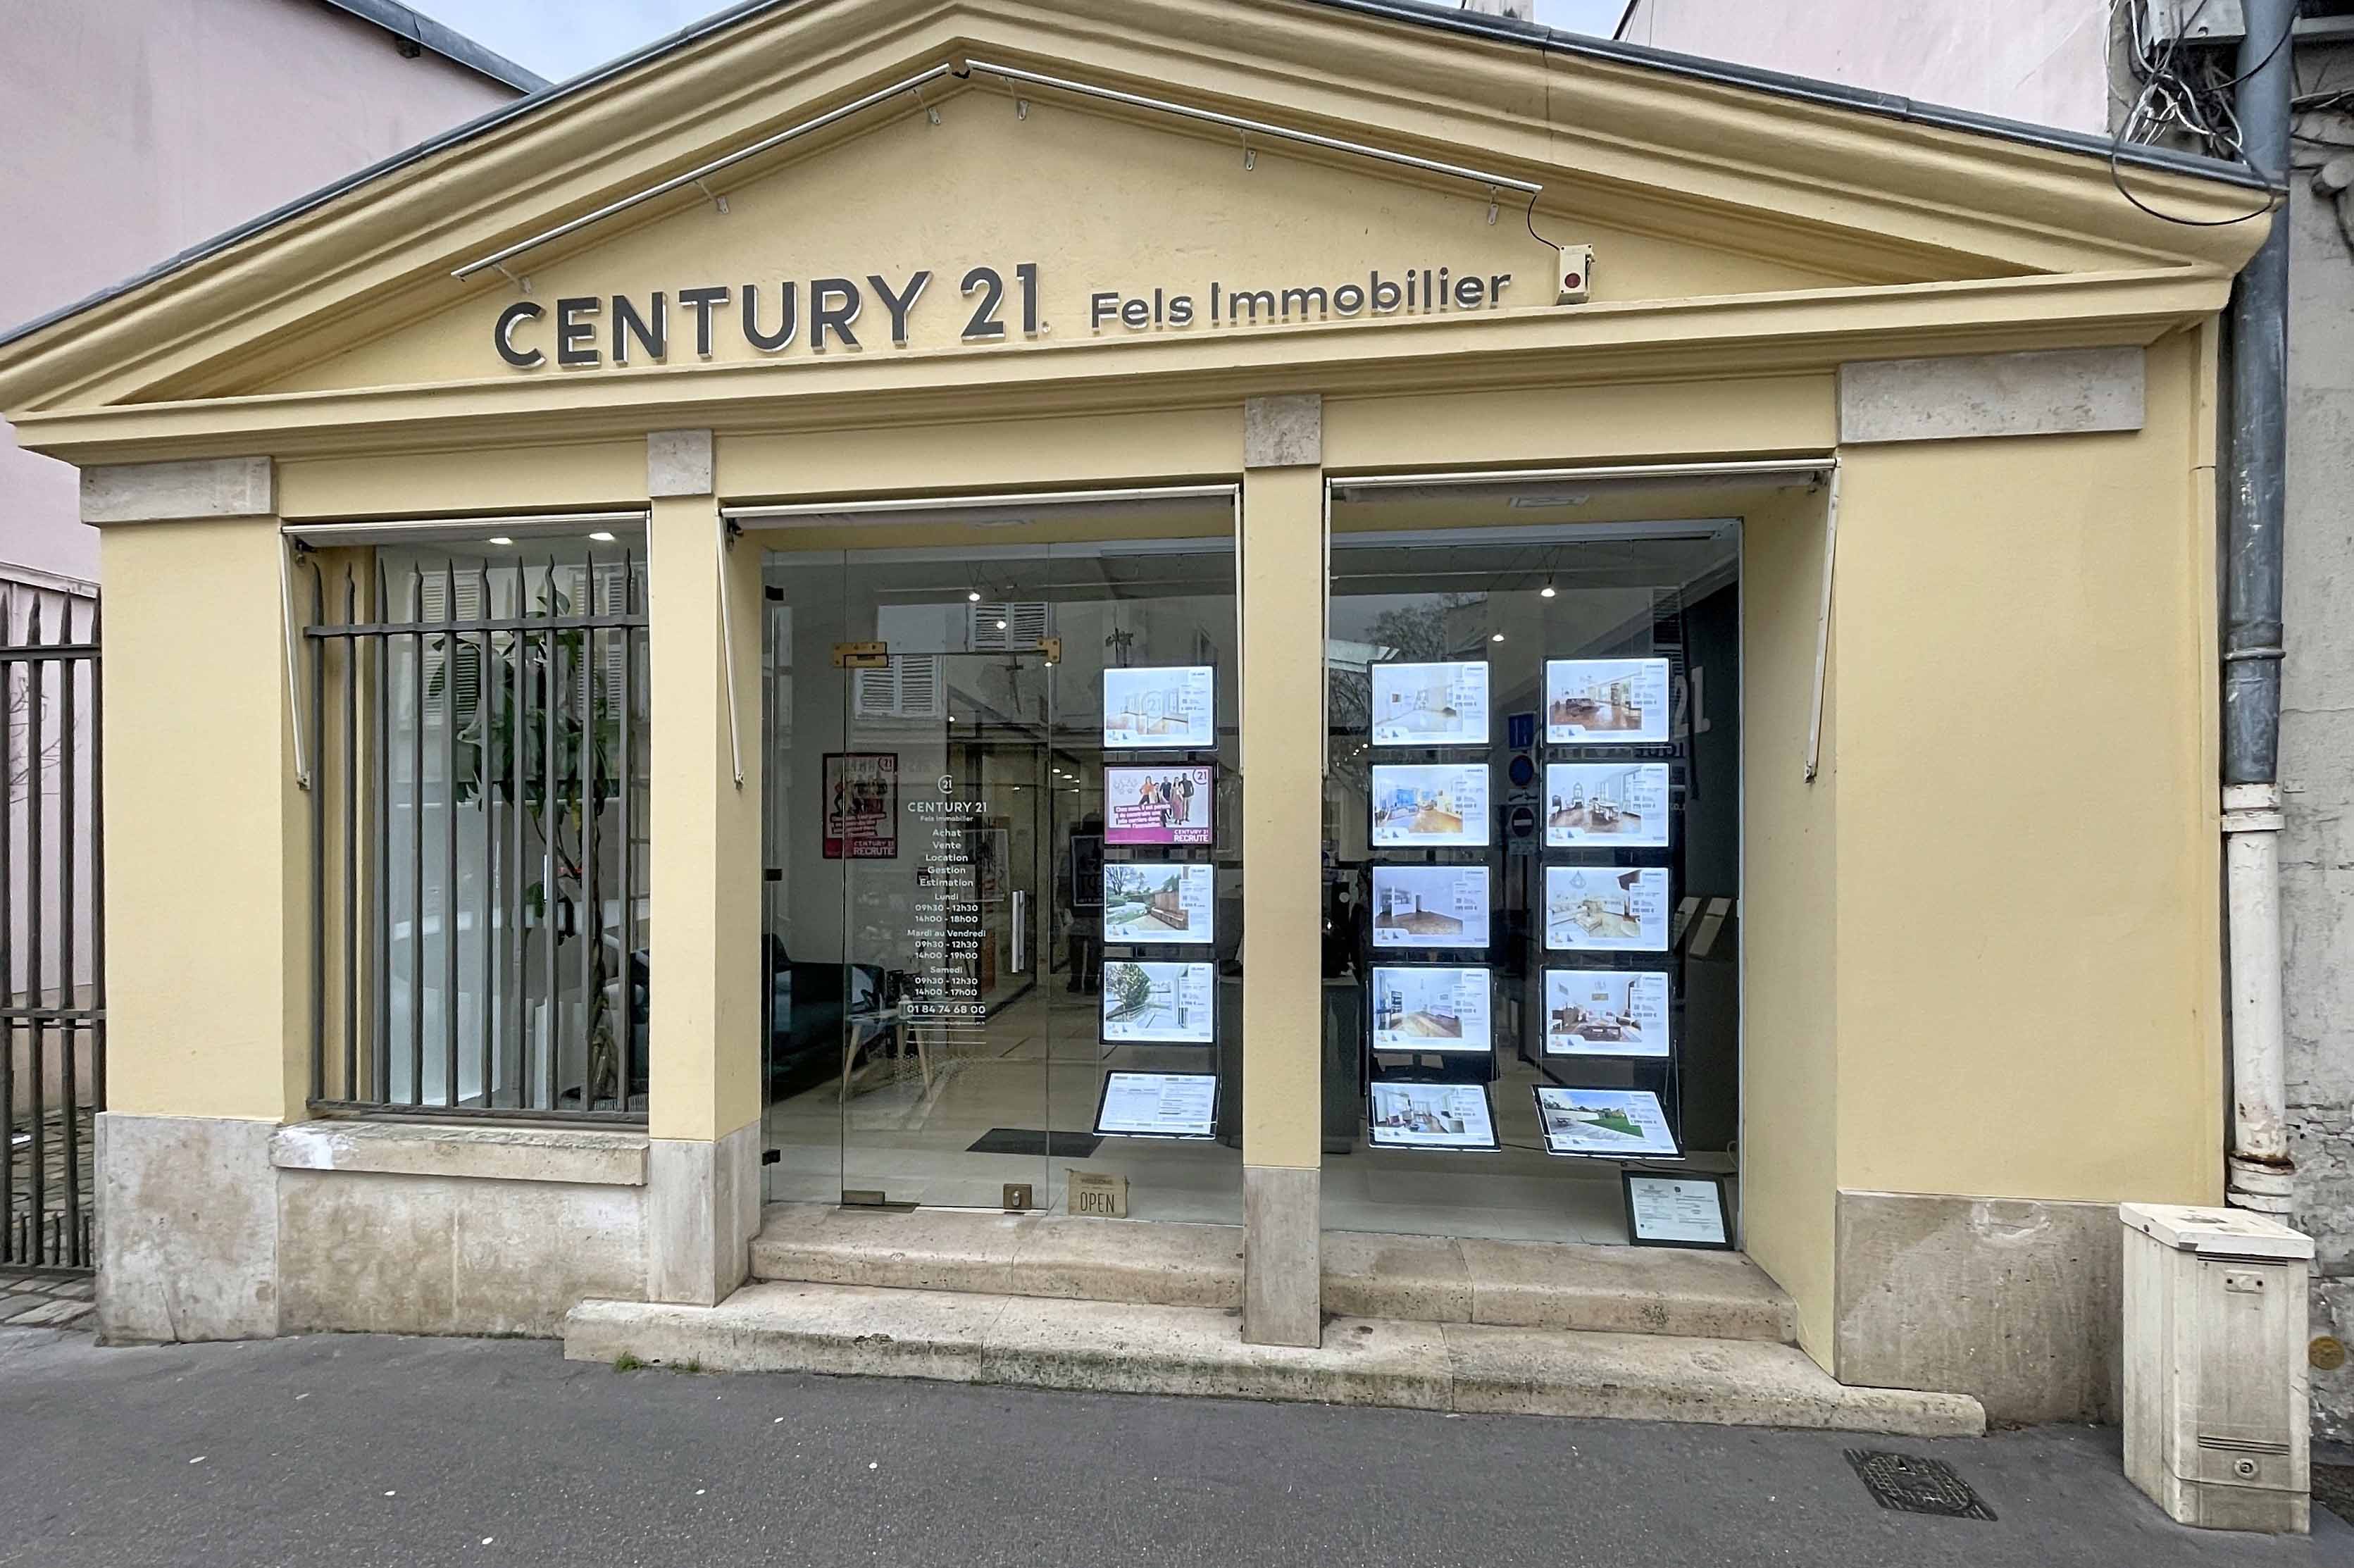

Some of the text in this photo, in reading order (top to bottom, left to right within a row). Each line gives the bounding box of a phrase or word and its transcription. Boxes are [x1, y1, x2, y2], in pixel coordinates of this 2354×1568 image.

[494, 263, 1512, 369] CENTURY 21 Fels Immobilier
[908, 802, 987, 812] CENTURY 21
[853, 847, 895, 855] RECRUTE
[928, 866, 966, 874] Gestion
[920, 878, 973, 887] Estimation
[947, 929, 986, 938] Vendredi
[907, 1005, 986, 1014] 01 84 74 68 00
[1080, 1191, 1115, 1213] OPEN
